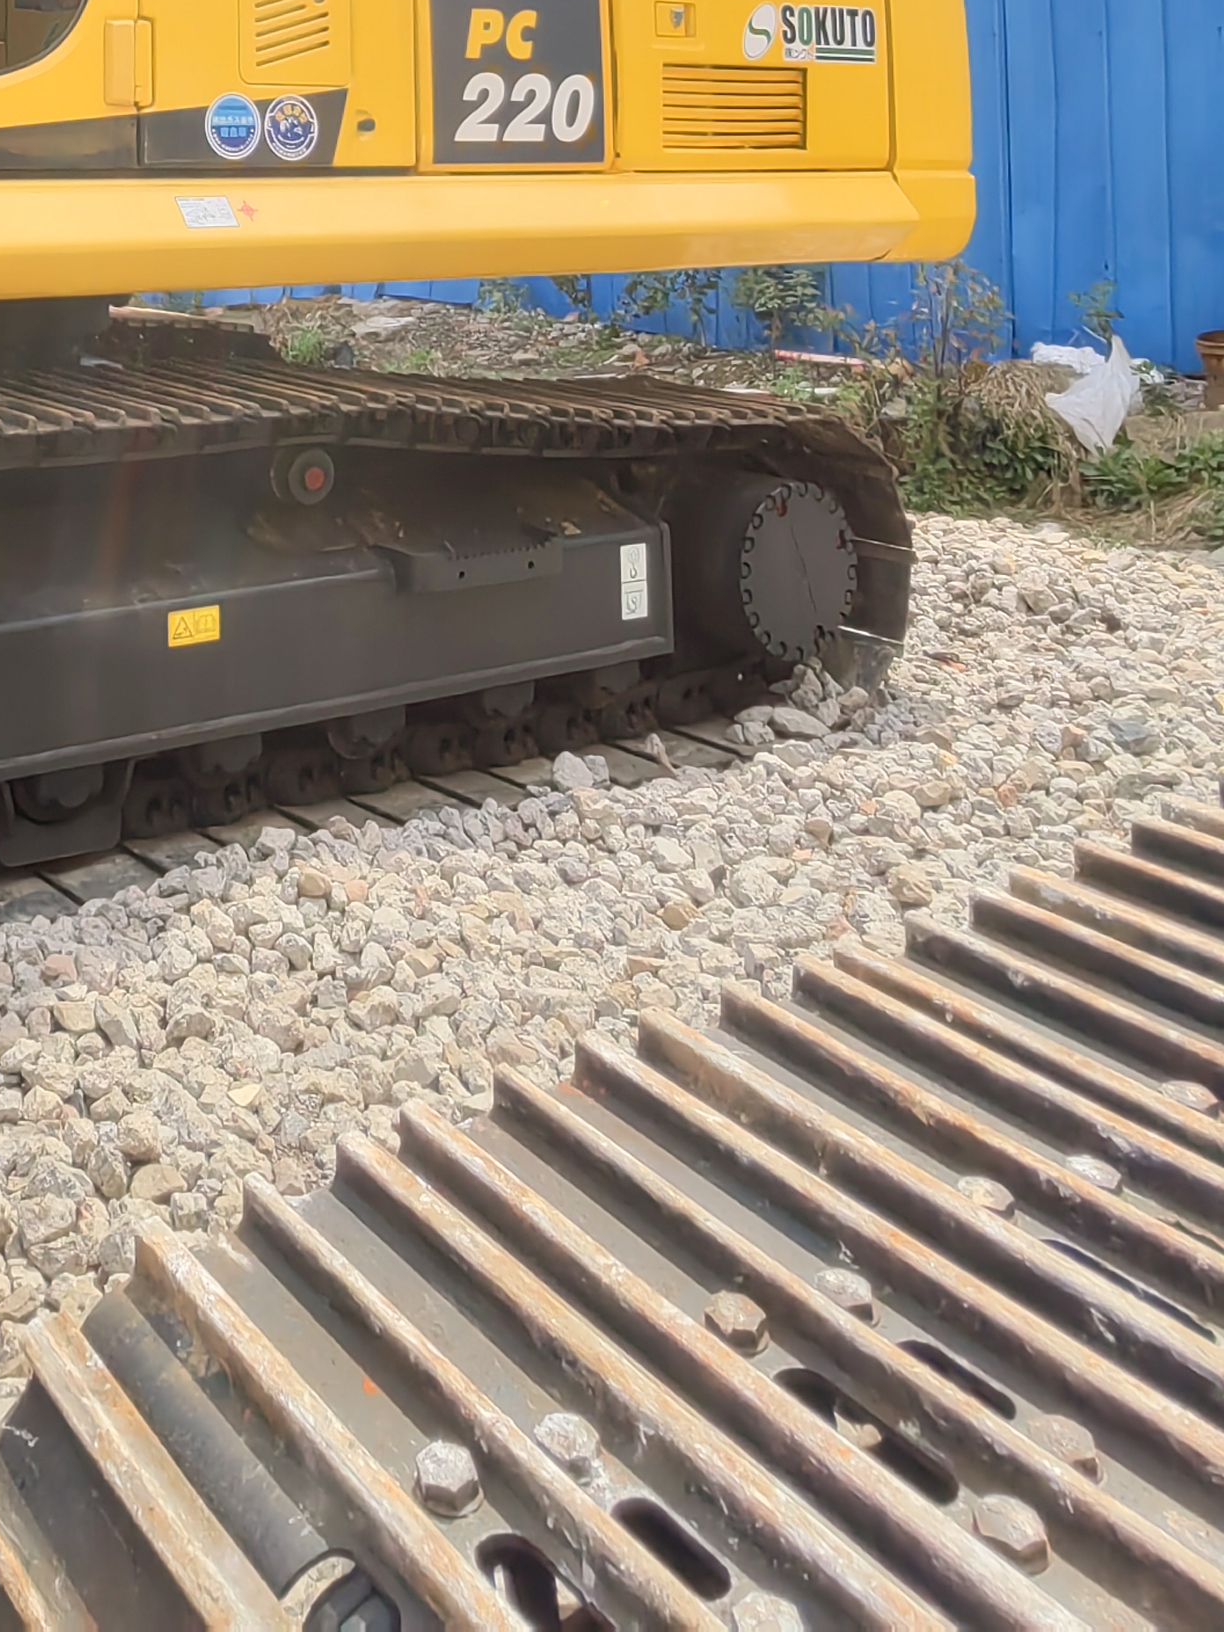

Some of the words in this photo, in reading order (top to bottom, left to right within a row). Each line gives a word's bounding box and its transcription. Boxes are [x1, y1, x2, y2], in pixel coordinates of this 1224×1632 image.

[465, 8, 537, 60] PC
[781, 5, 875, 47] SOKUTO
[454, 72, 594, 142] 220
